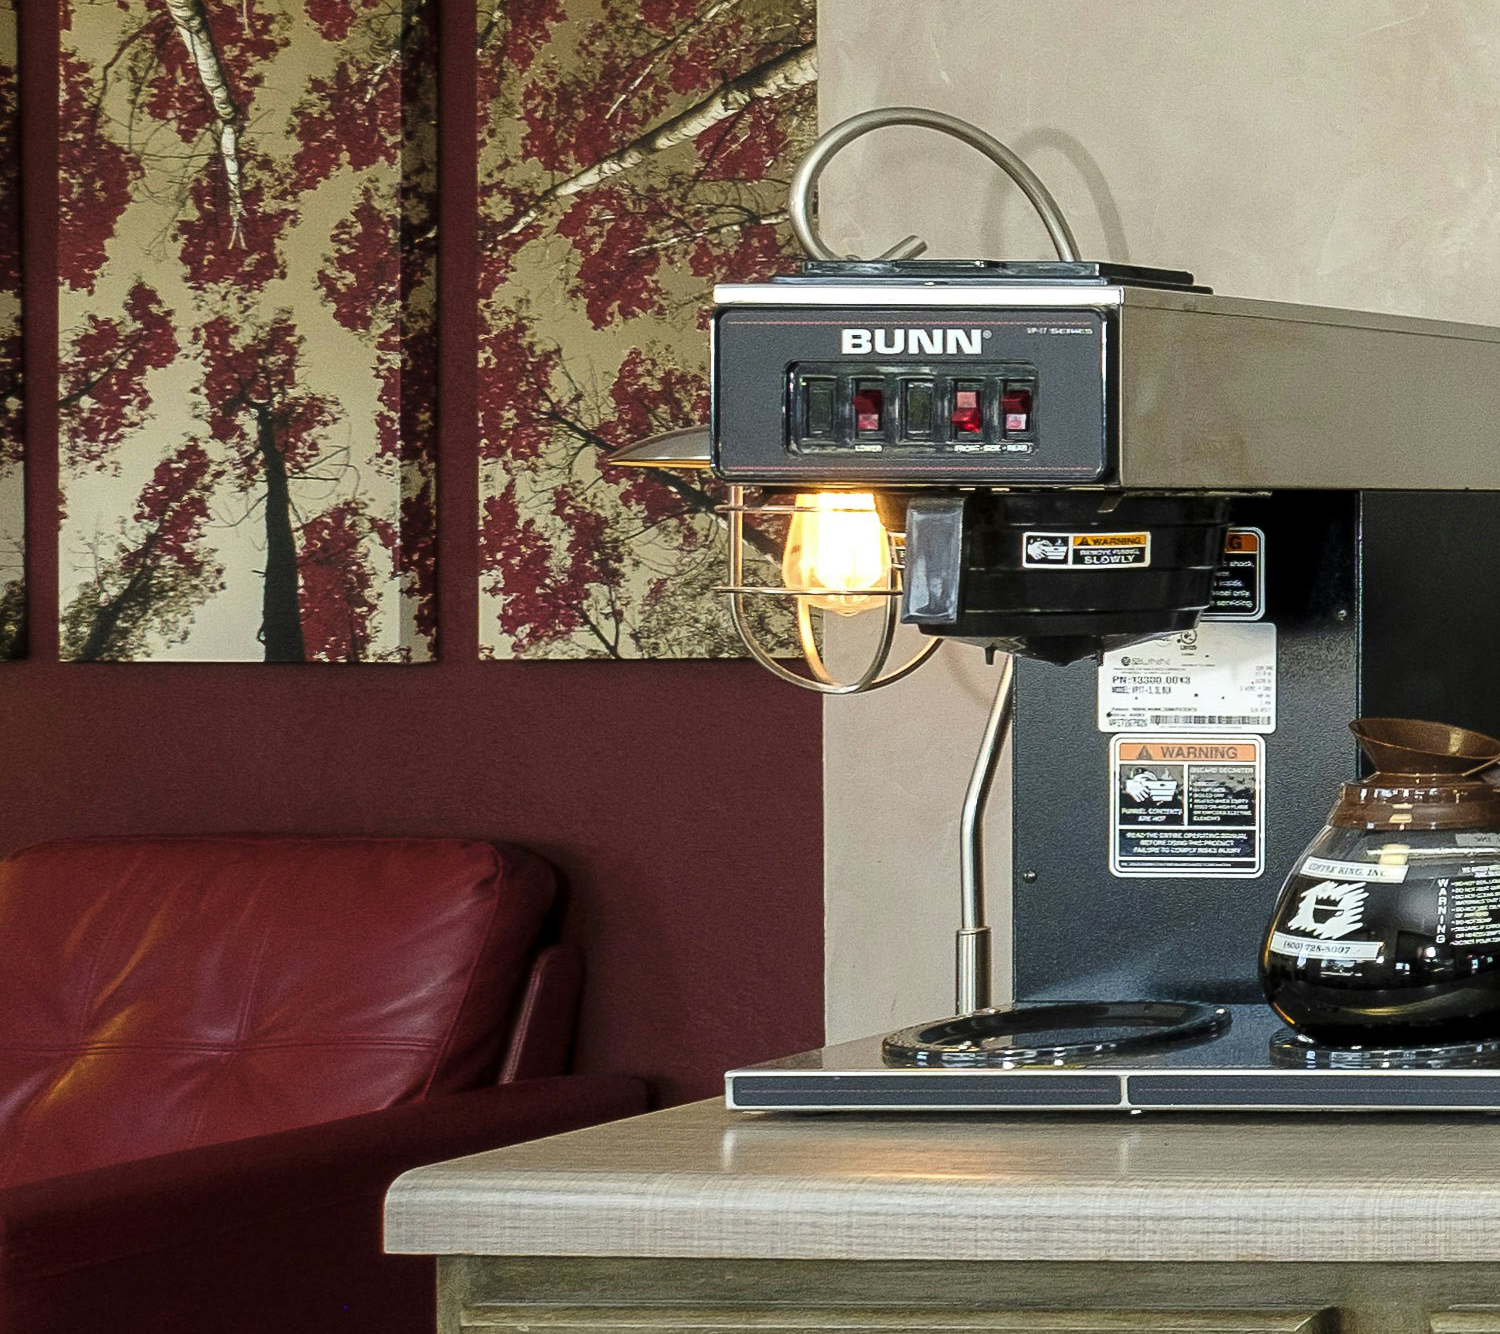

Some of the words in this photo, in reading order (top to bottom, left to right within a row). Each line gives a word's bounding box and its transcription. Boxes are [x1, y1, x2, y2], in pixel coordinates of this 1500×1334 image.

[841, 328, 983, 355] BUNN
[1091, 537, 1143, 546] WARNING
[1084, 555, 1135, 565] SLOWLY
[1160, 746, 1238, 759] WARNING
[1436, 878, 1449, 944] WARNING
